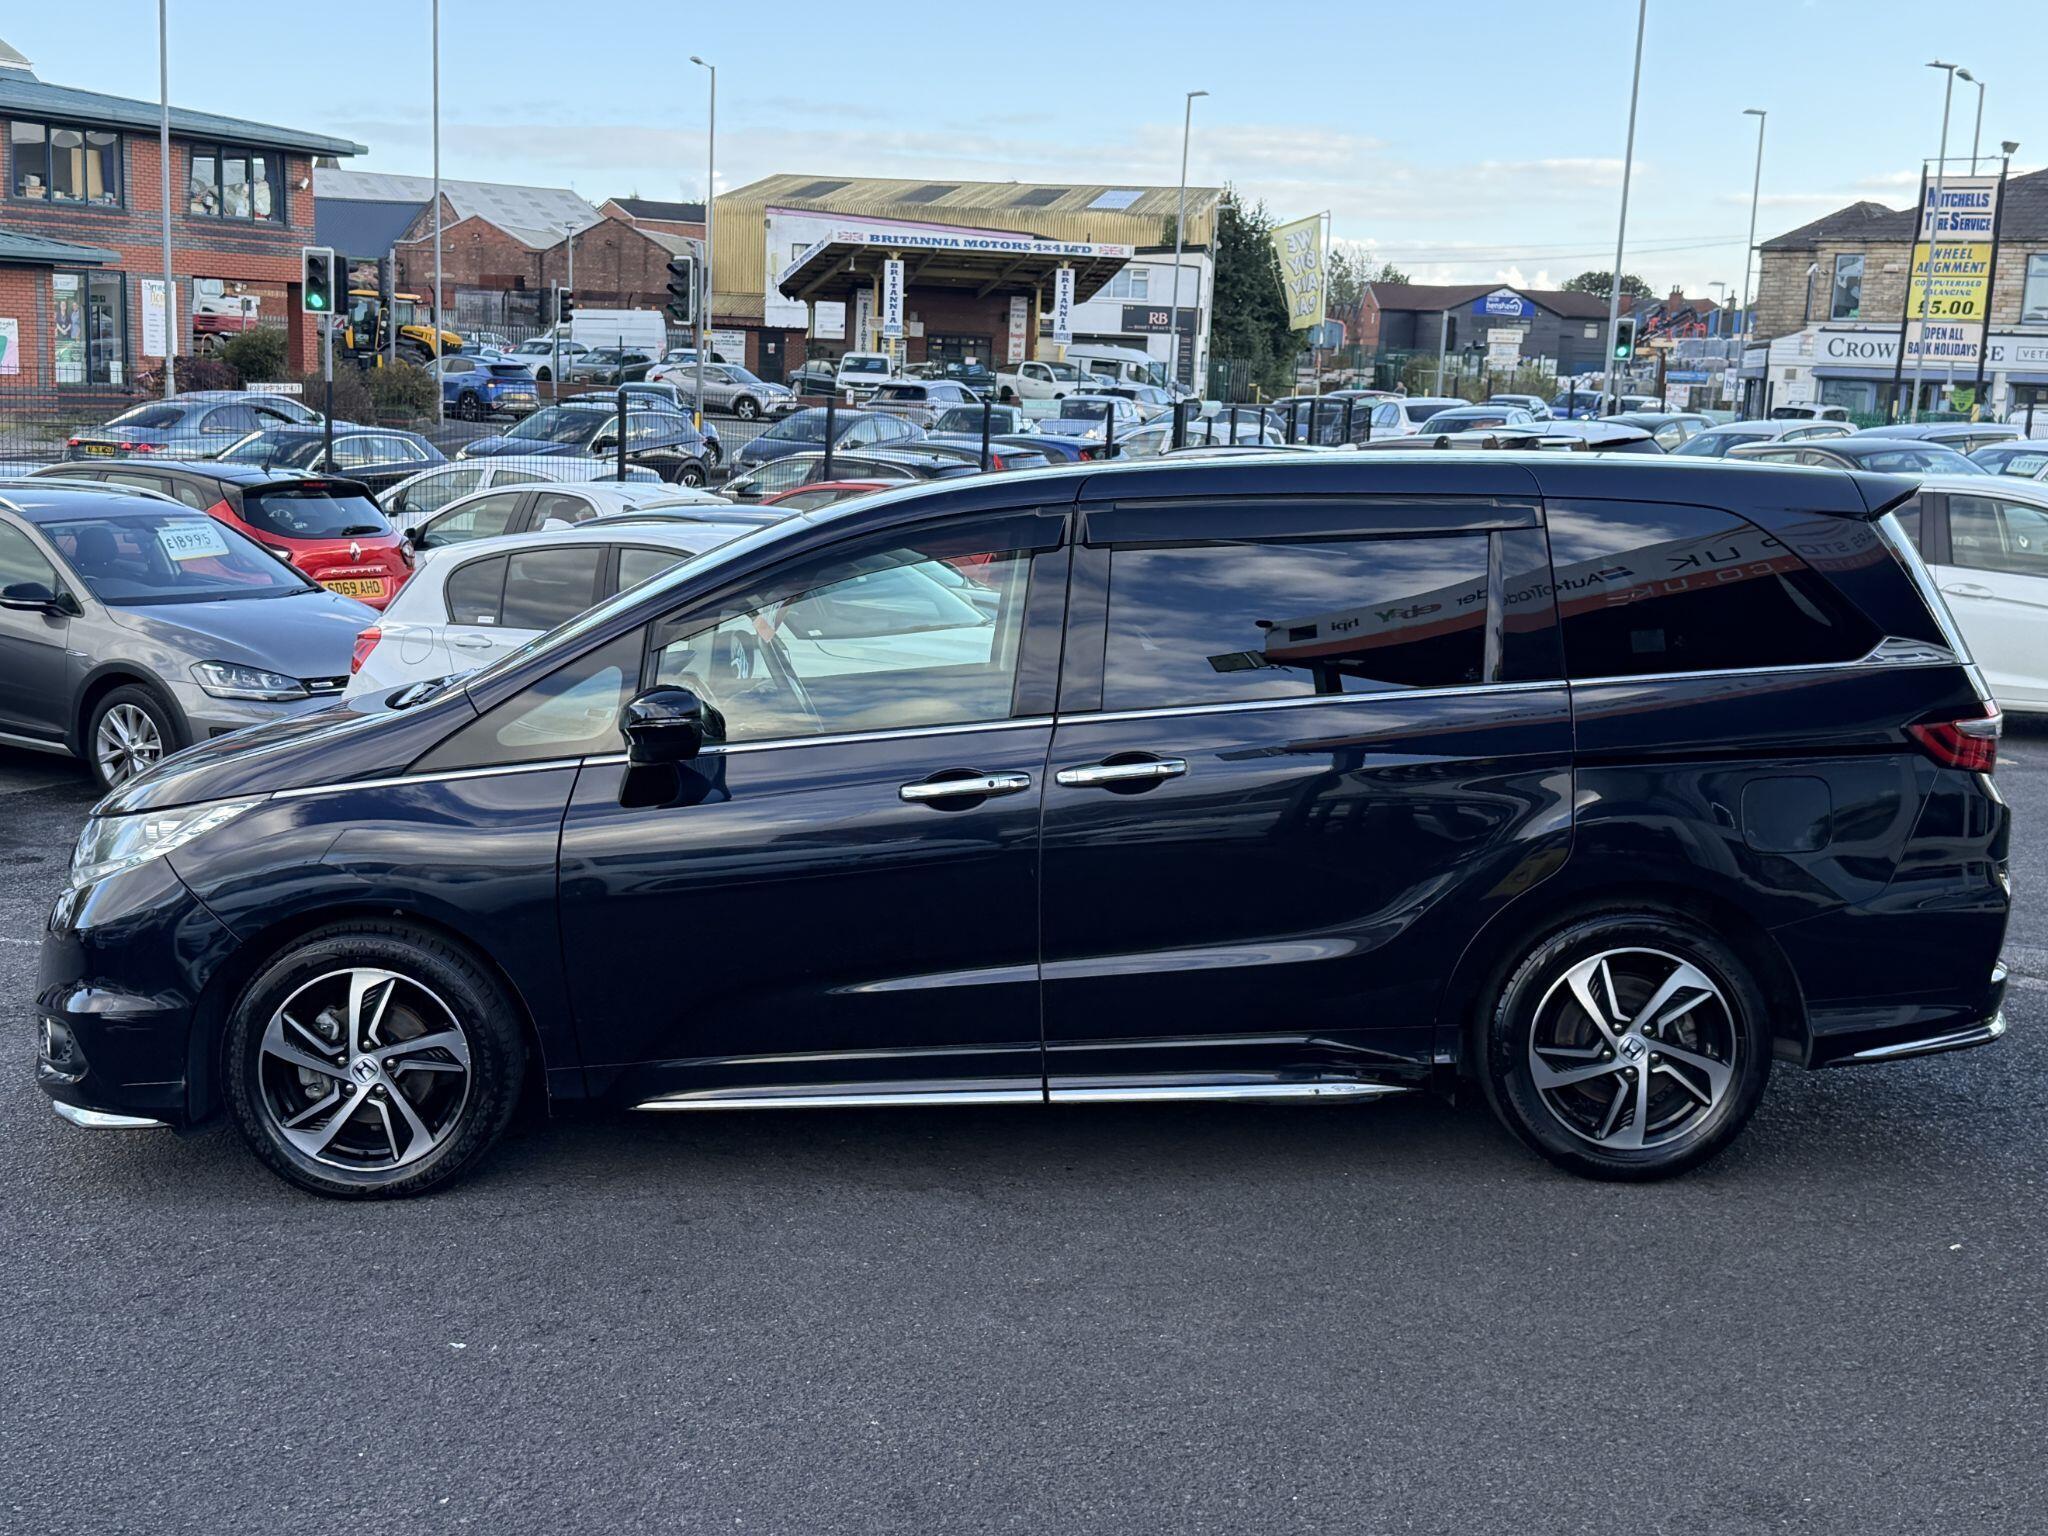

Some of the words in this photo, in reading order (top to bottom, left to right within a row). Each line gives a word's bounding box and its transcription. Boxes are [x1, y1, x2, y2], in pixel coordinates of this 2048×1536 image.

[1950, 212, 1990, 230] SERVICE
[869, 234, 960, 248] BRITANNIA
[963, 239, 1032, 252] MOTORS
[1064, 244, 1093, 255] LTD
[889, 262, 899, 324] BRITANNIA
[1059, 270, 1070, 331] BRITANNIA
[1148, 311, 1168, 325] RB
[1924, 327, 1947, 341] OPEN
[1949, 328, 1964, 341] ALL
[1933, 342, 1978, 357] HOLIDAYS
